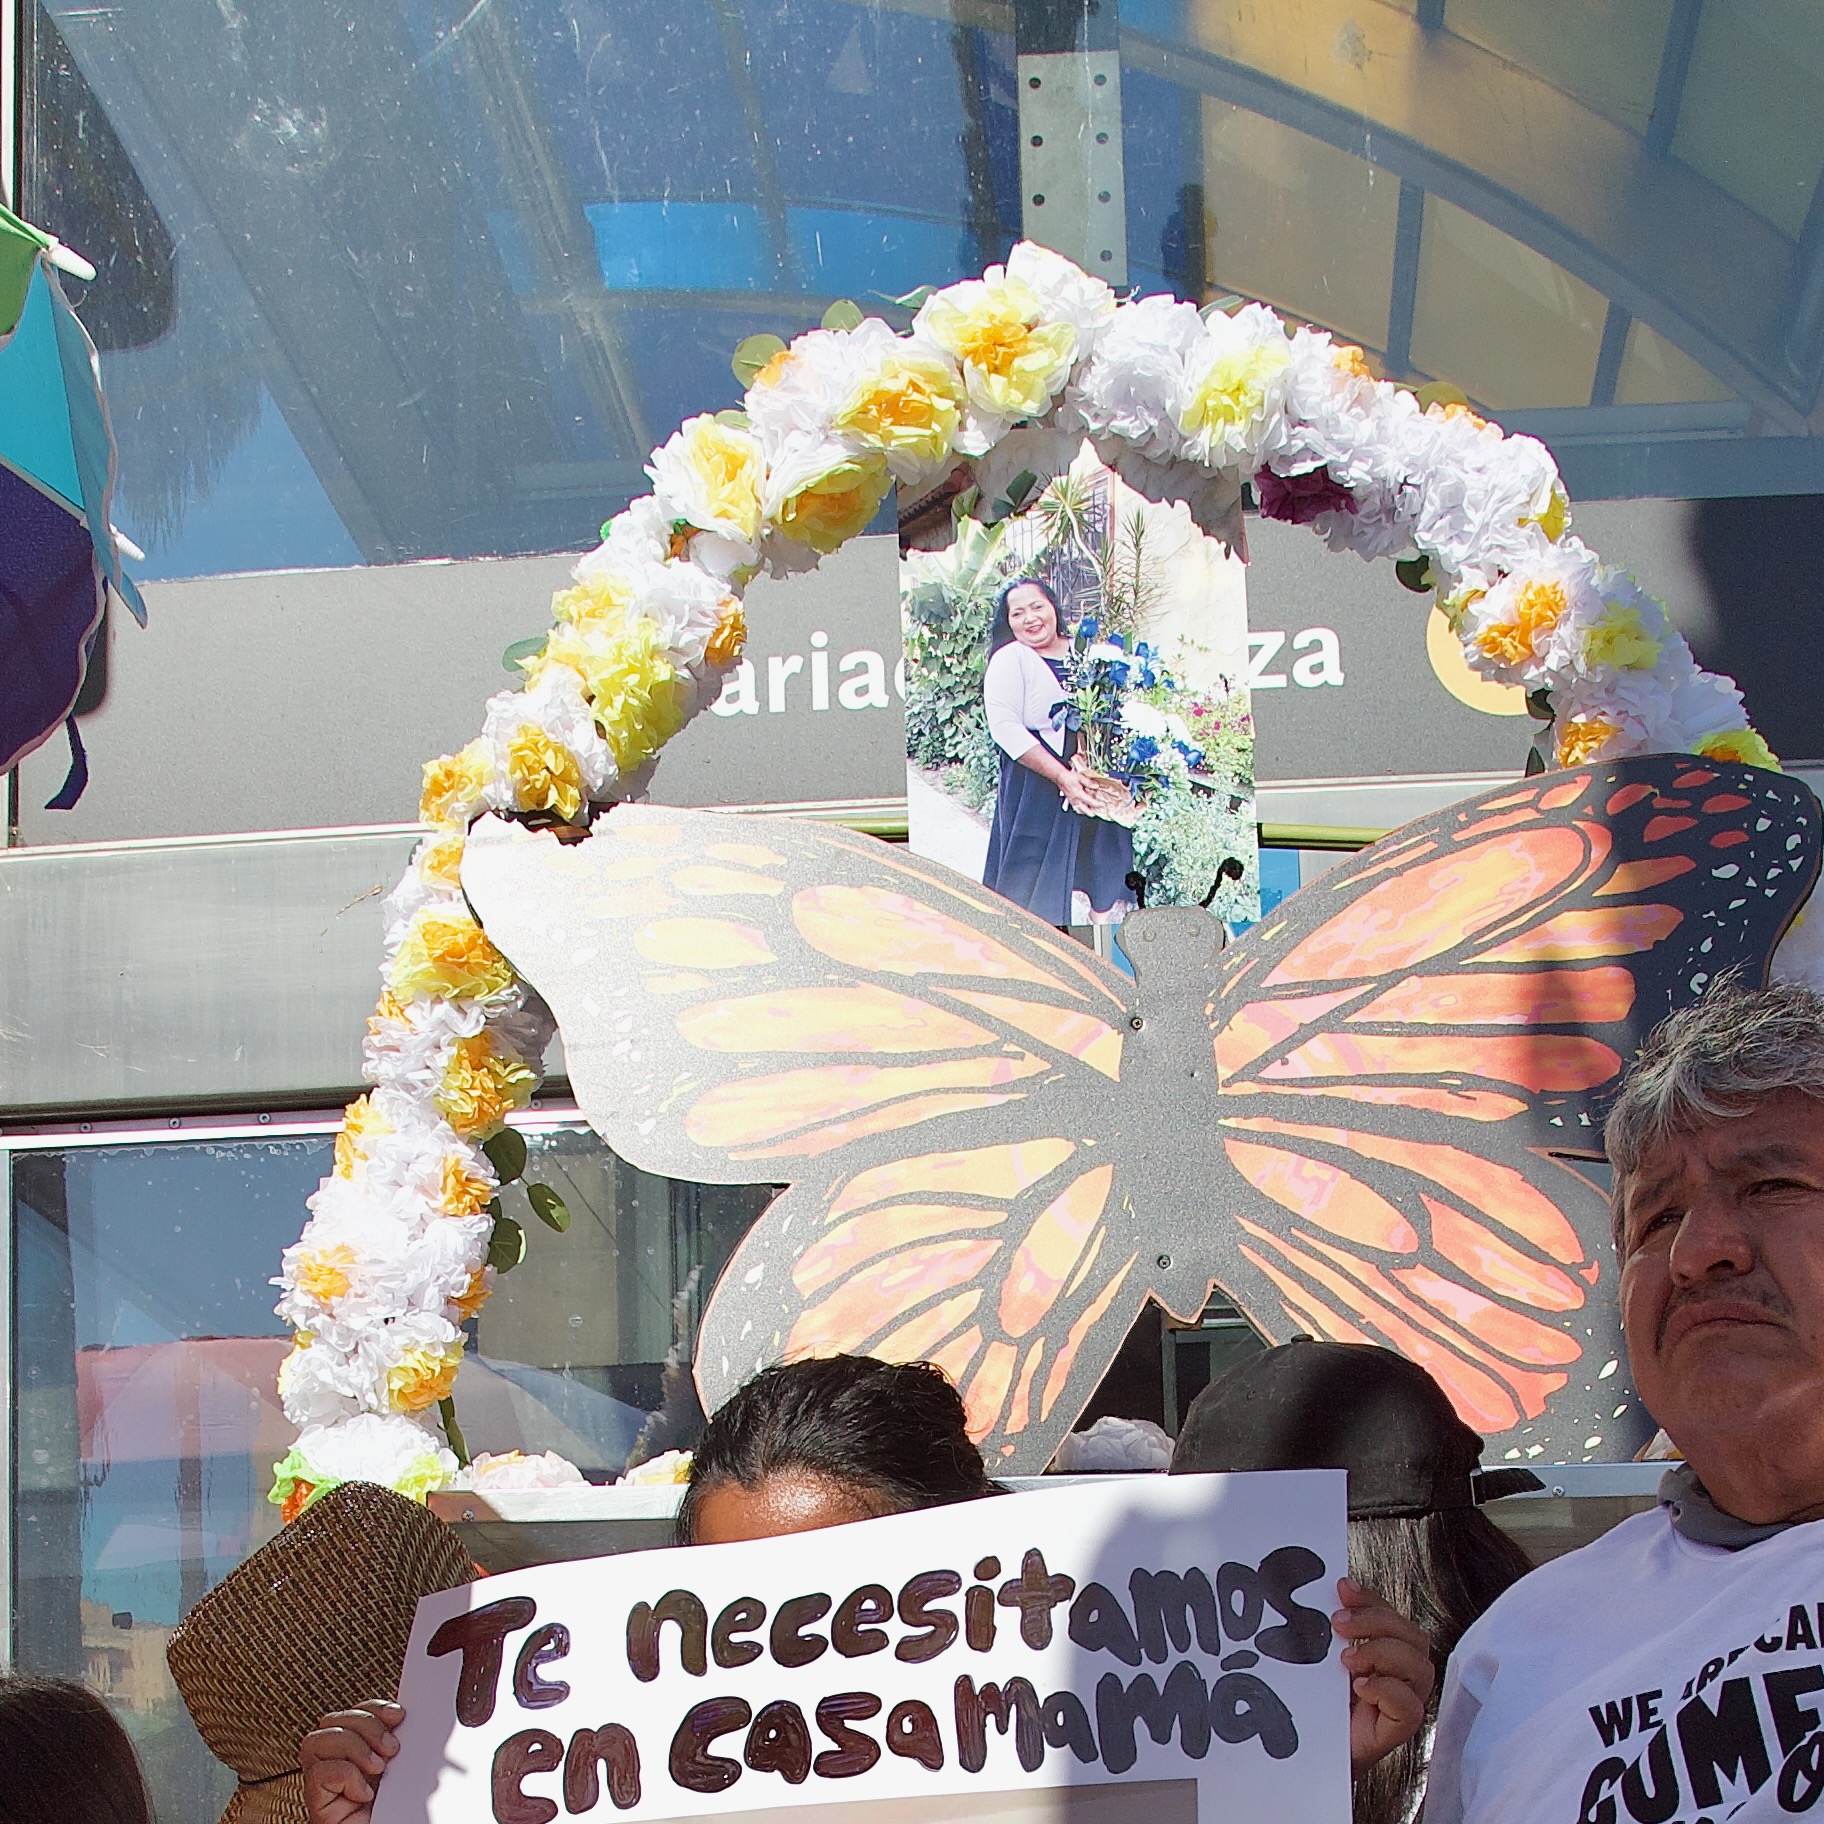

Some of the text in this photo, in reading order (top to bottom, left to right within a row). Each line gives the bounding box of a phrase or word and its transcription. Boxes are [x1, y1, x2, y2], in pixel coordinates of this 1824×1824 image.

[427, 1549, 1333, 1726] Te necesitamos
[669, 1689, 942, 1793] casa
[1587, 1687, 1663, 1747] WE
